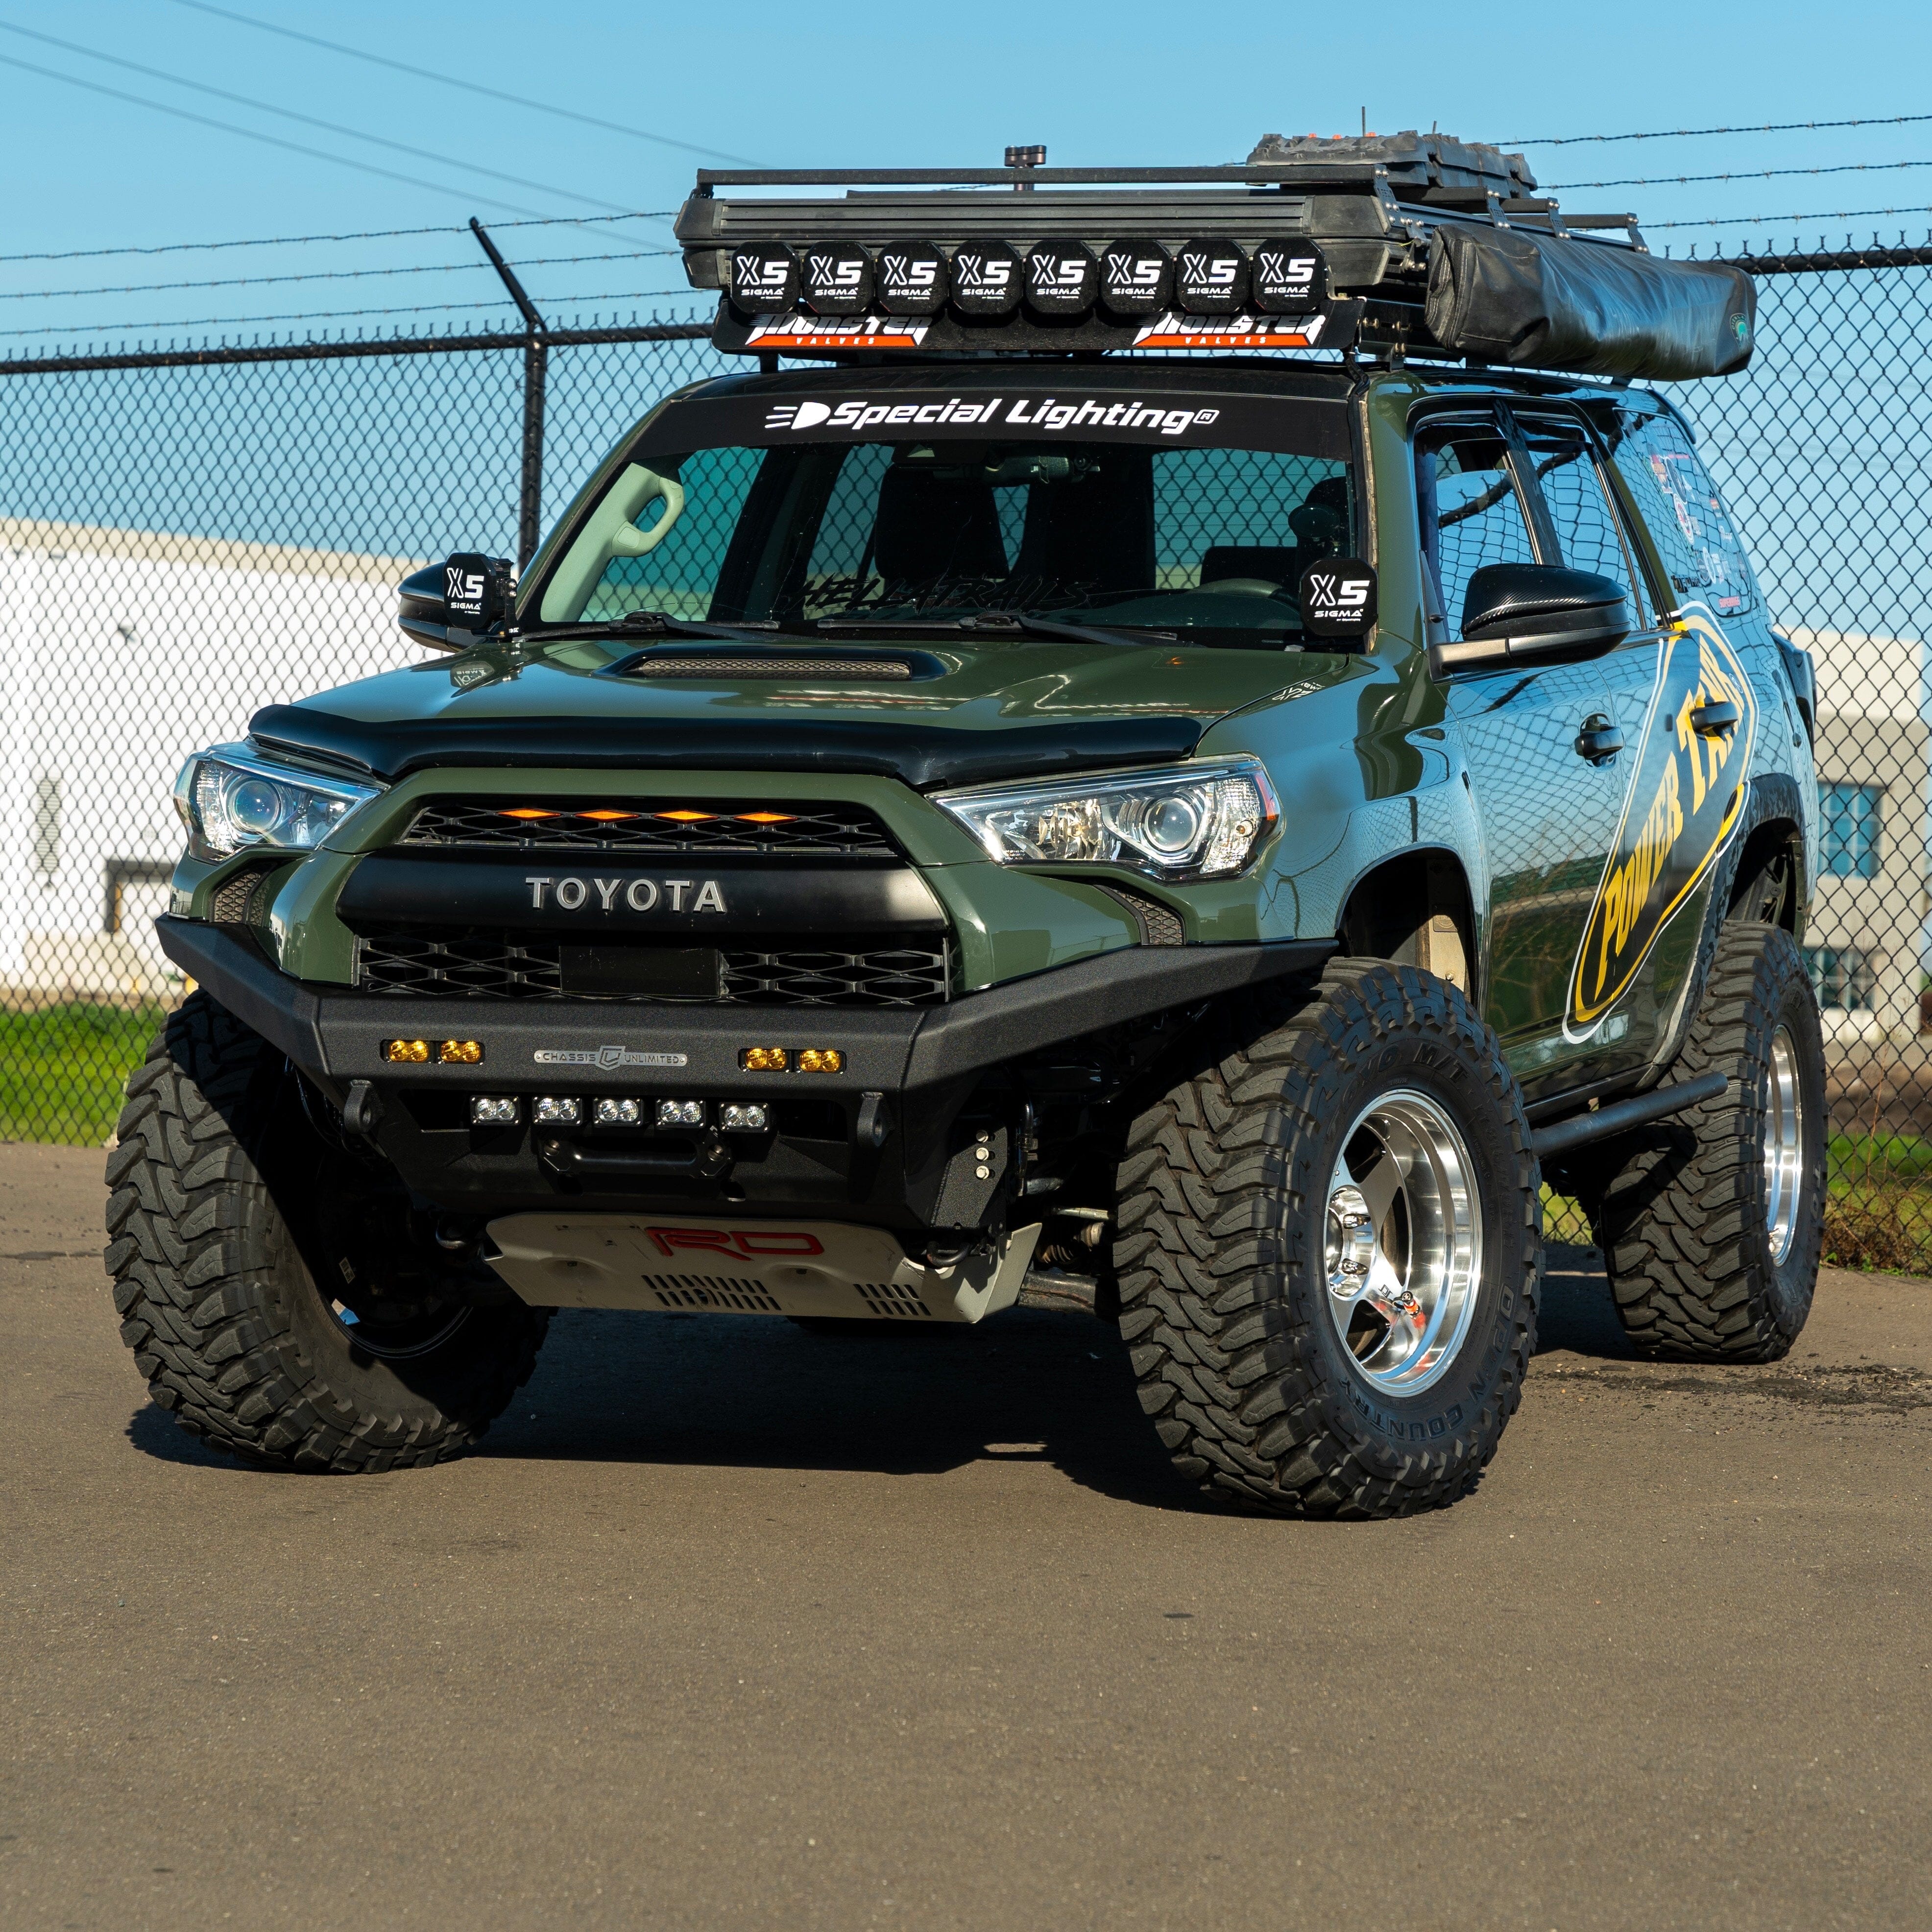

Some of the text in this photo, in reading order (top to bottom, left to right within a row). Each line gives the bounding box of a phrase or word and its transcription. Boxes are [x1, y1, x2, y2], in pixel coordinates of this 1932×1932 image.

[745, 313, 933, 345] MONSTER
[1133, 312, 1326, 345] MONSTER
[826, 398, 1003, 430] Special
[1594, 751, 1684, 1003] POWER
[526, 877, 726, 913] TOYOTA
[543, 1052, 679, 1064] CHASSIS UNLIMITED
[1338, 1377, 1465, 1441] COUNTRY
